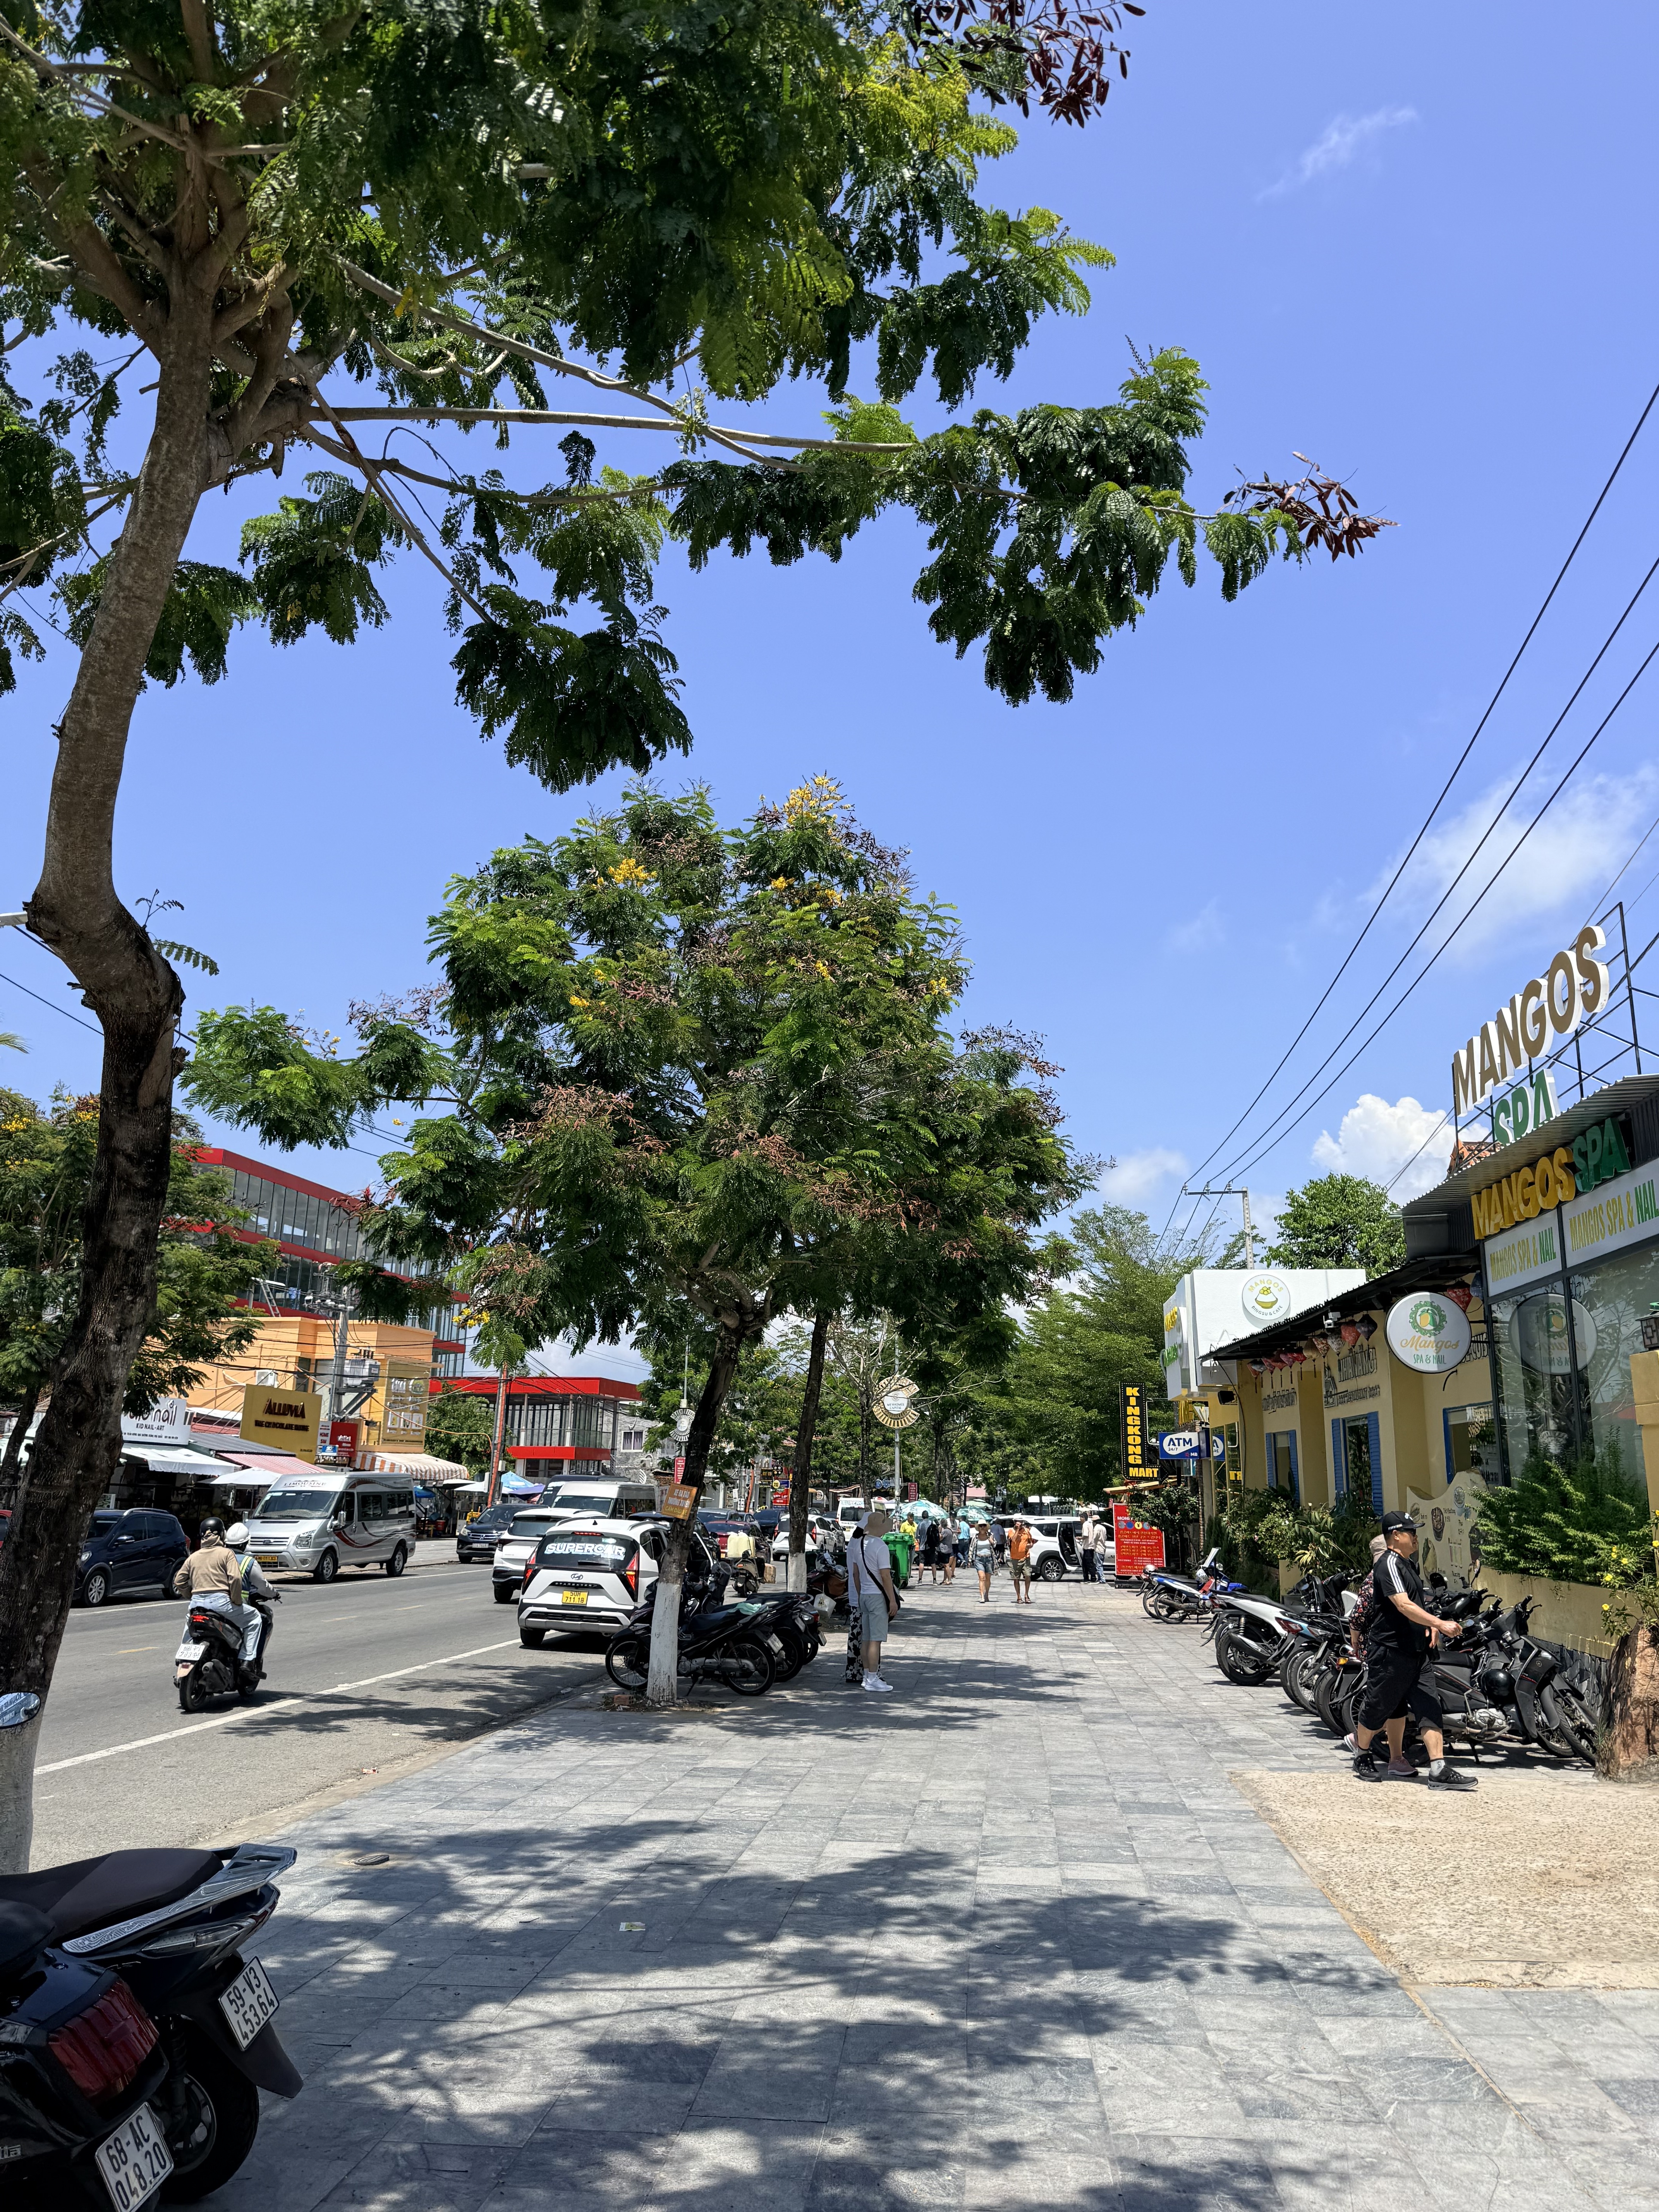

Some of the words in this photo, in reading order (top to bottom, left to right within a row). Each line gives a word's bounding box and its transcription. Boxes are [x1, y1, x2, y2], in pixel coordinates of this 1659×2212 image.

[1454, 926, 1609, 1116] MANGOS
[1494, 1069, 1561, 1145] SPA
[1471, 1147, 1575, 1240] MANGOS
[1573, 1118, 1631, 1192] SPA
[1569, 1204, 1606, 1252] MANGOS
[1606, 1195, 1625, 1236] SPA
[1626, 1190, 1634, 1228] &
[1634, 1179, 1659, 1224] NAIL
[1490, 1243, 1516, 1283] MANGOS
[1517, 1237, 1531, 1272] SPA
[1532, 1235, 1539, 1266] &
[1539, 1227, 1556, 1264] NAIL
[1248, 1279, 1283, 1292] MANGOS
[1400, 1335, 1459, 1354] Mangos
[1413, 1354, 1424, 1364] SPA
[1425, 1355, 1431, 1364] &
[1432, 1354, 1446, 1364] NAIL
[1126, 1387, 1142, 1464] KINGKONG
[1168, 1437, 1192, 1447] ATM
[1129, 1467, 1159, 1477] MART
[544, 1542, 625, 1557] SUPERCAR
[227, 1966, 261, 2014] 59-V3
[237, 1987, 275, 2040] 453.64
[106, 2115, 150, 2173] 68-AC
[115, 2142, 166, 2210] 048.20
